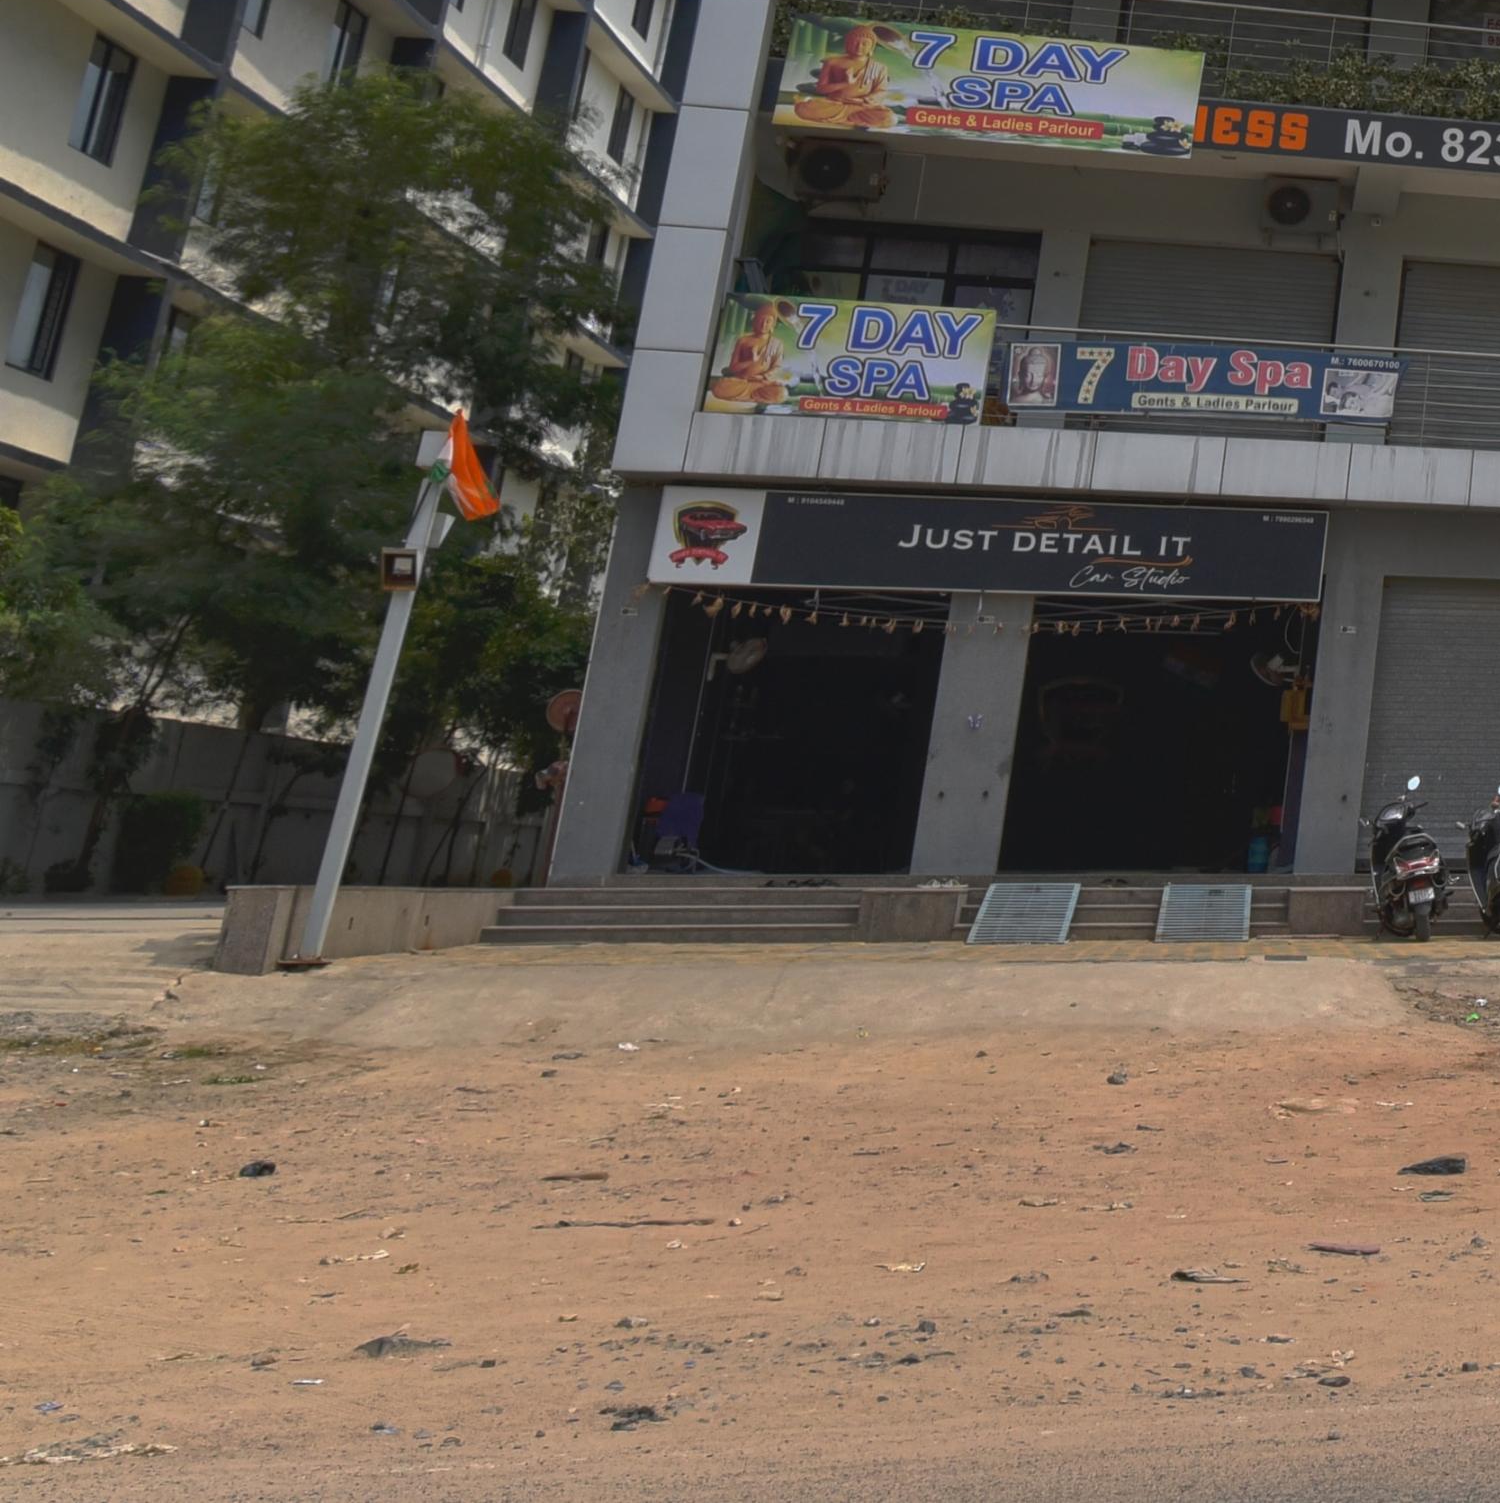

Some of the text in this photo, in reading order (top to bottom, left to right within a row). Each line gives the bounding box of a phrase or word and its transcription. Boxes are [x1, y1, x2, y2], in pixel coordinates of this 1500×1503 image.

[909, 31, 1131, 85] 7 DAY
[945, 75, 1075, 118] SPA
[914, 109, 1095, 138] Gents & Ladies Parlour
[1196, 106, 1310, 151] ESS
[1344, 118, 1425, 162] Mo.
[796, 304, 986, 359] 7 DAY
[825, 355, 930, 401] SPA
[1076, 345, 1313, 406] 7 Day Spa
[803, 398, 944, 420] Gents & Ladies Parlour
[1137, 394, 1295, 412] Gents & Ladies Parlour
[898, 523, 1192, 557] JUST DETAIL IT
[1068, 564, 1191, 591] Car Studio
